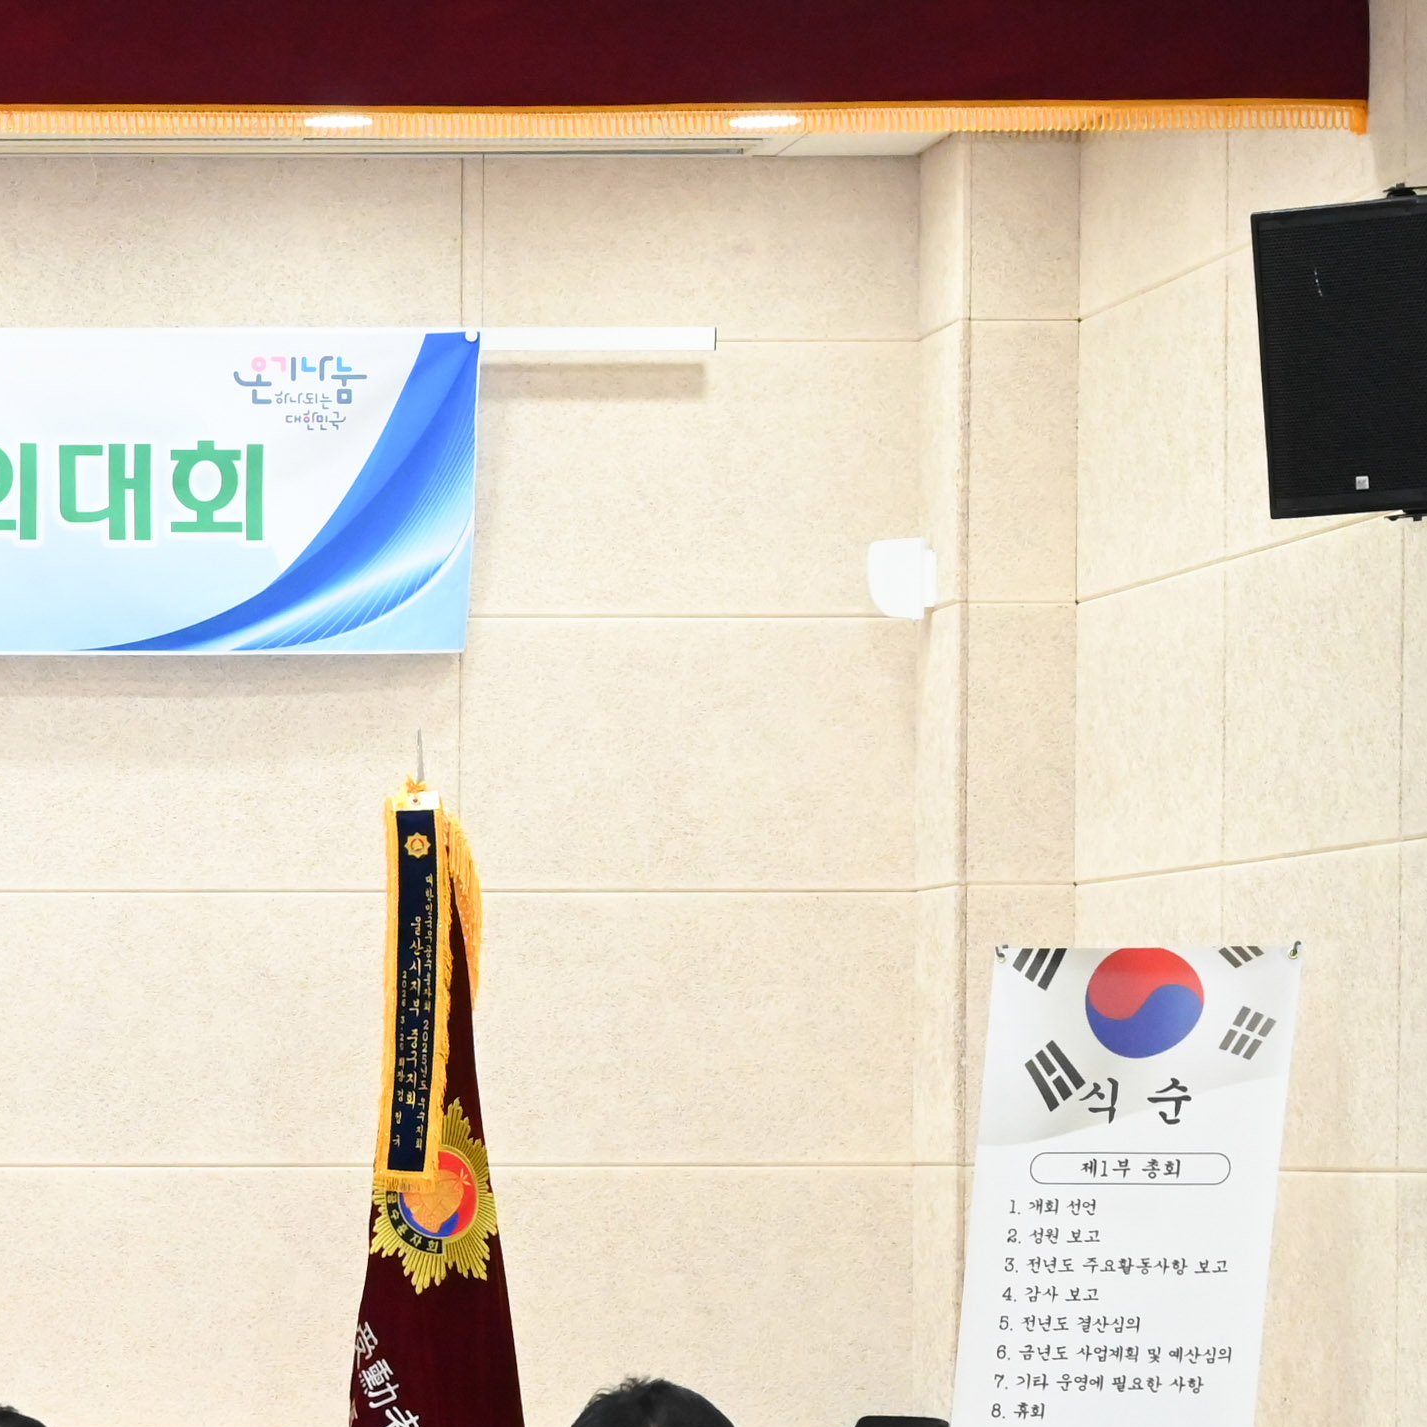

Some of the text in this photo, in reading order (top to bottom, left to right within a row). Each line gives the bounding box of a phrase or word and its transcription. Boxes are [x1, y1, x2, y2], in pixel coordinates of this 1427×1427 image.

[233, 355, 367, 405] 온기나눔
[274, 391, 333, 410] 하나되는
[285, 409, 347, 431] 대한민국
[405, 1027, 420, 1110] 중구지회
[1079, 1076, 1191, 1125] 식 순
[1082, 1159, 1180, 1179] 제1부 총회
[1010, 1198, 1096, 1215] 1. 개회 선언
[1007, 1228, 1100, 1244] 2. 성원 보고
[1005, 1256, 1227, 1275] 3. 전년도 주요활동사항 보고
[1002, 1286, 1098, 1302] 4. 감사 보고
[999, 1315, 1140, 1333] 5. 전년도 결산심의
[997, 1345, 1231, 1364] 6. 금년도 사업계획 및 예산심의
[994, 1373, 1204, 1394] 7. 기타 운영에 필요한 사항
[991, 1402, 1045, 1419] 8. 휴회
